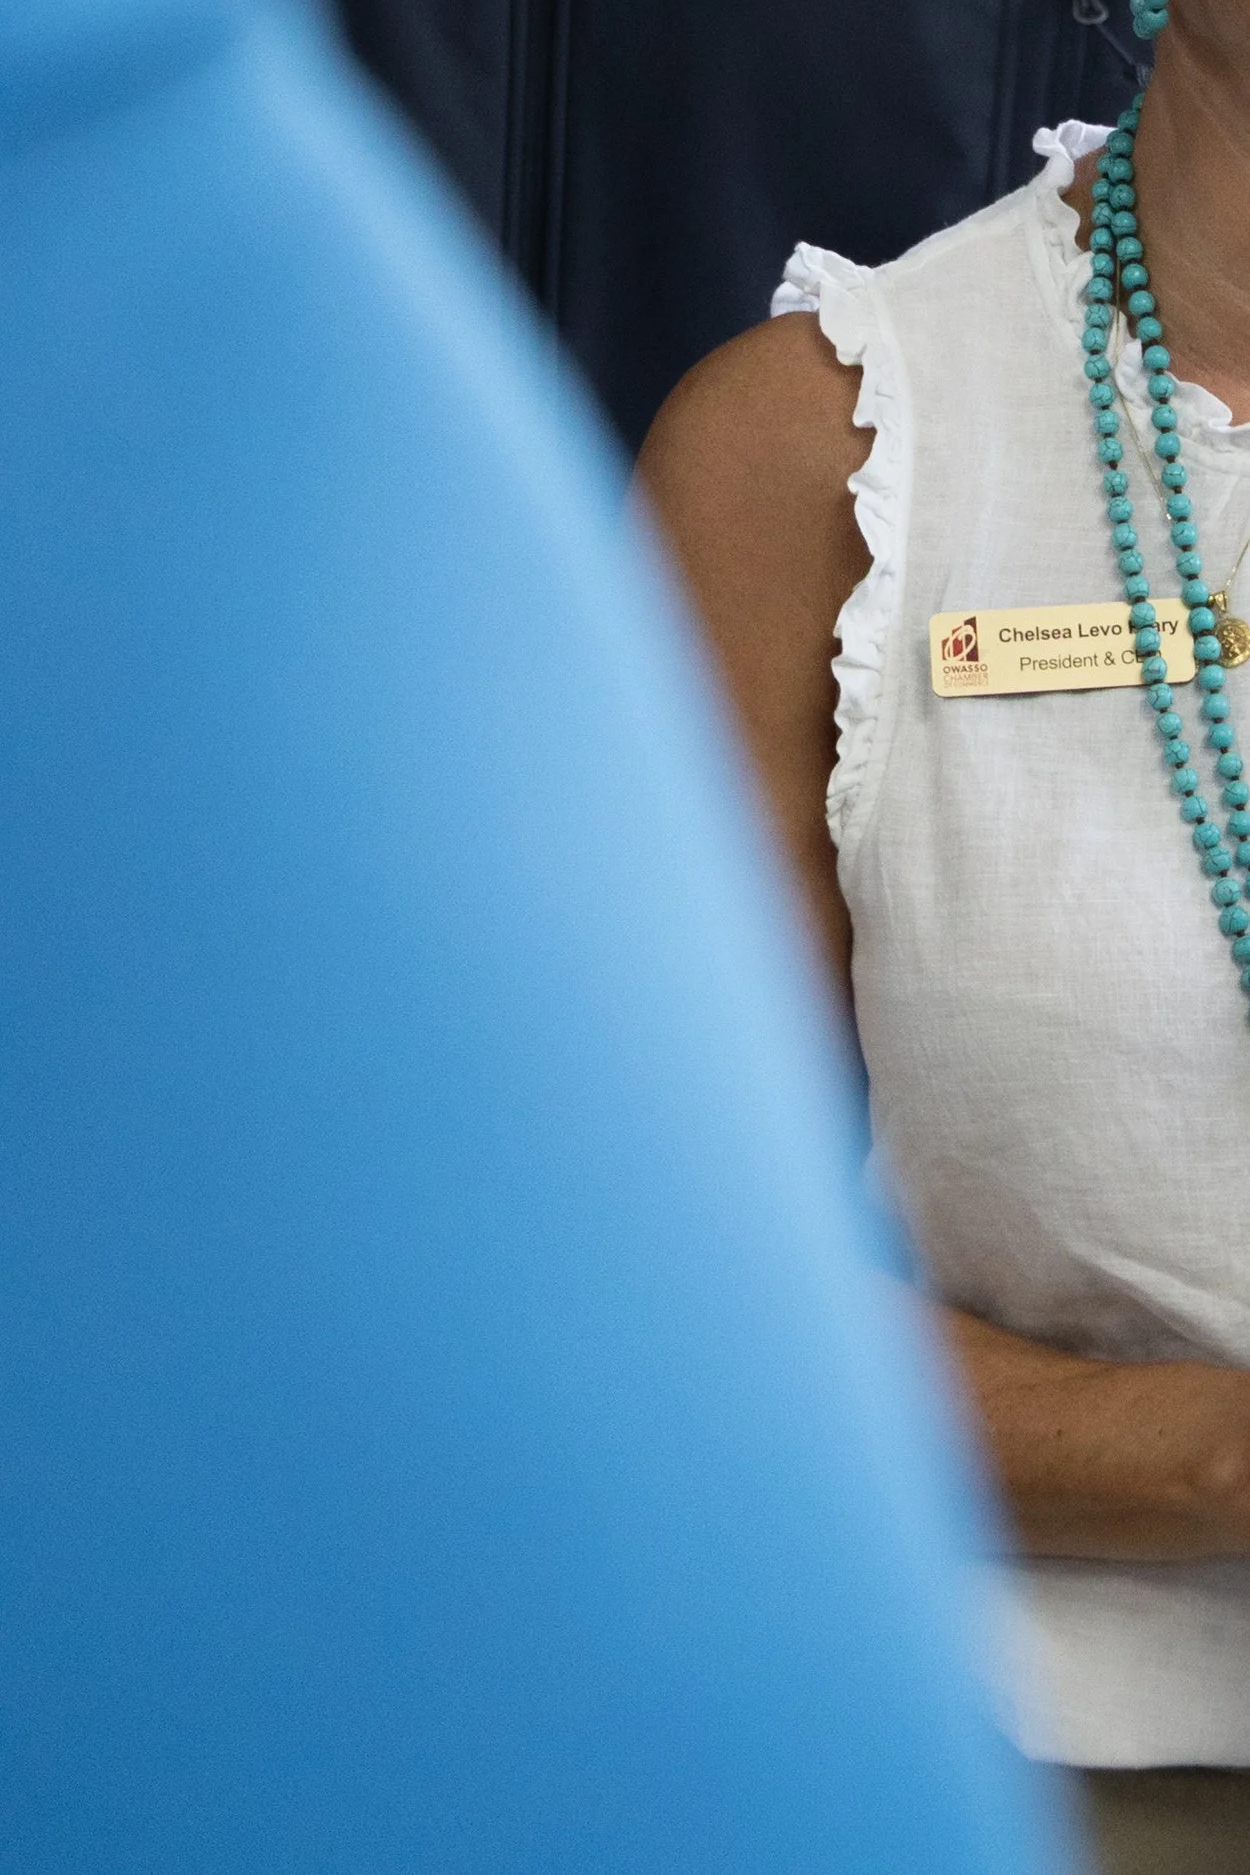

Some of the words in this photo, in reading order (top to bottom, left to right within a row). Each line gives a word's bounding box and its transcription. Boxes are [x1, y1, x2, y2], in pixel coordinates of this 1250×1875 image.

[998, 626, 1072, 642] Chelsea
[1078, 623, 1122, 638] Levo
[943, 663, 988, 674] OWASSO
[1020, 653, 1098, 671] President
[1103, 651, 1116, 666] &
[1121, 649, 1162, 665] CE
